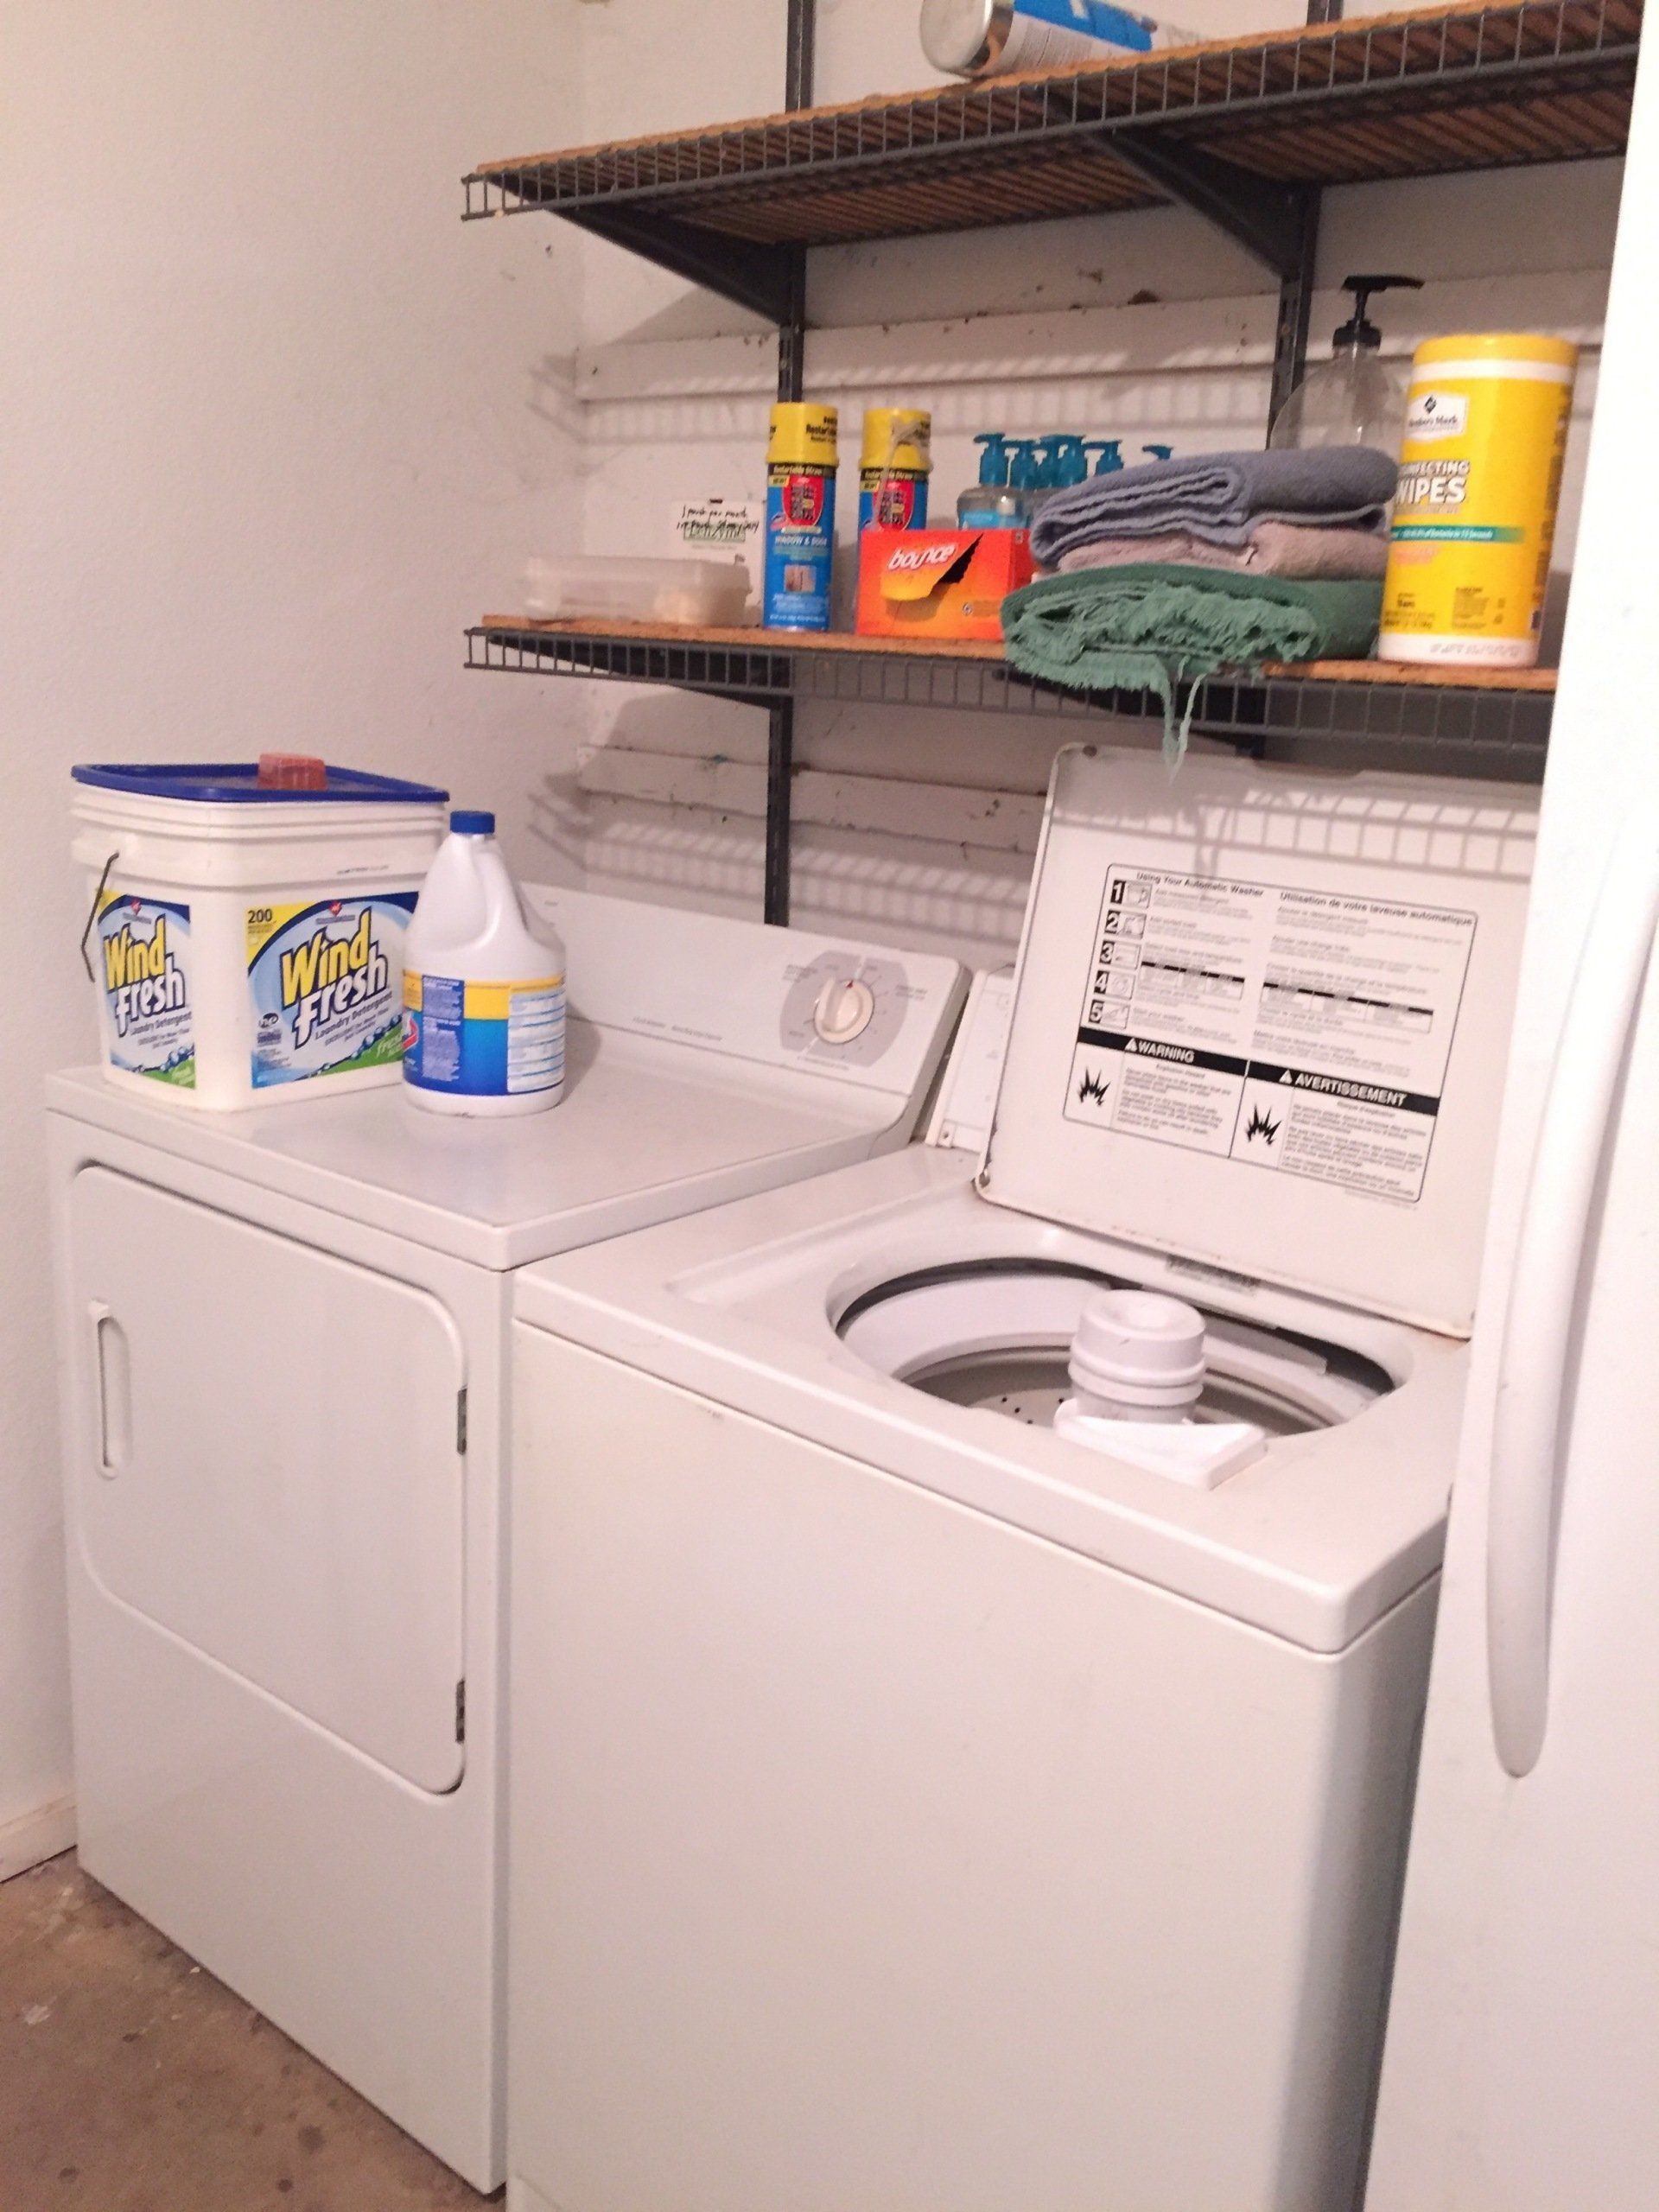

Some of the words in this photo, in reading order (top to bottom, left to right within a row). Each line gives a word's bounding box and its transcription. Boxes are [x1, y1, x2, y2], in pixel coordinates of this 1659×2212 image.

[888, 543, 957, 569] bounce
[1112, 880, 1123, 903] 1
[1136, 872, 1161, 883] Using
[1164, 876, 1182, 886] Your
[1184, 879, 1228, 892] Automatic
[1230, 886, 1265, 896] Washer
[248, 909, 272, 924] 200
[1106, 911, 1120, 932] 2
[1329, 898, 1341, 907] de
[1344, 901, 1367, 912] votre
[1409, 910, 1473, 927] automatique
[104, 913, 166, 994] Wind
[280, 906, 372, 1010] Wind
[1101, 942, 1114, 963] 3
[115, 952, 185, 1037] Fresh
[1096, 972, 1108, 993] 4
[292, 941, 388, 1050] Fresh
[315, 1016, 350, 1039] Laundry
[353, 991, 392, 1020] Detergent
[1090, 1001, 1103, 1022] 5
[1138, 1040, 1195, 1064] WARNING
[1295, 1072, 1408, 1107] AVERTISSEMENT
